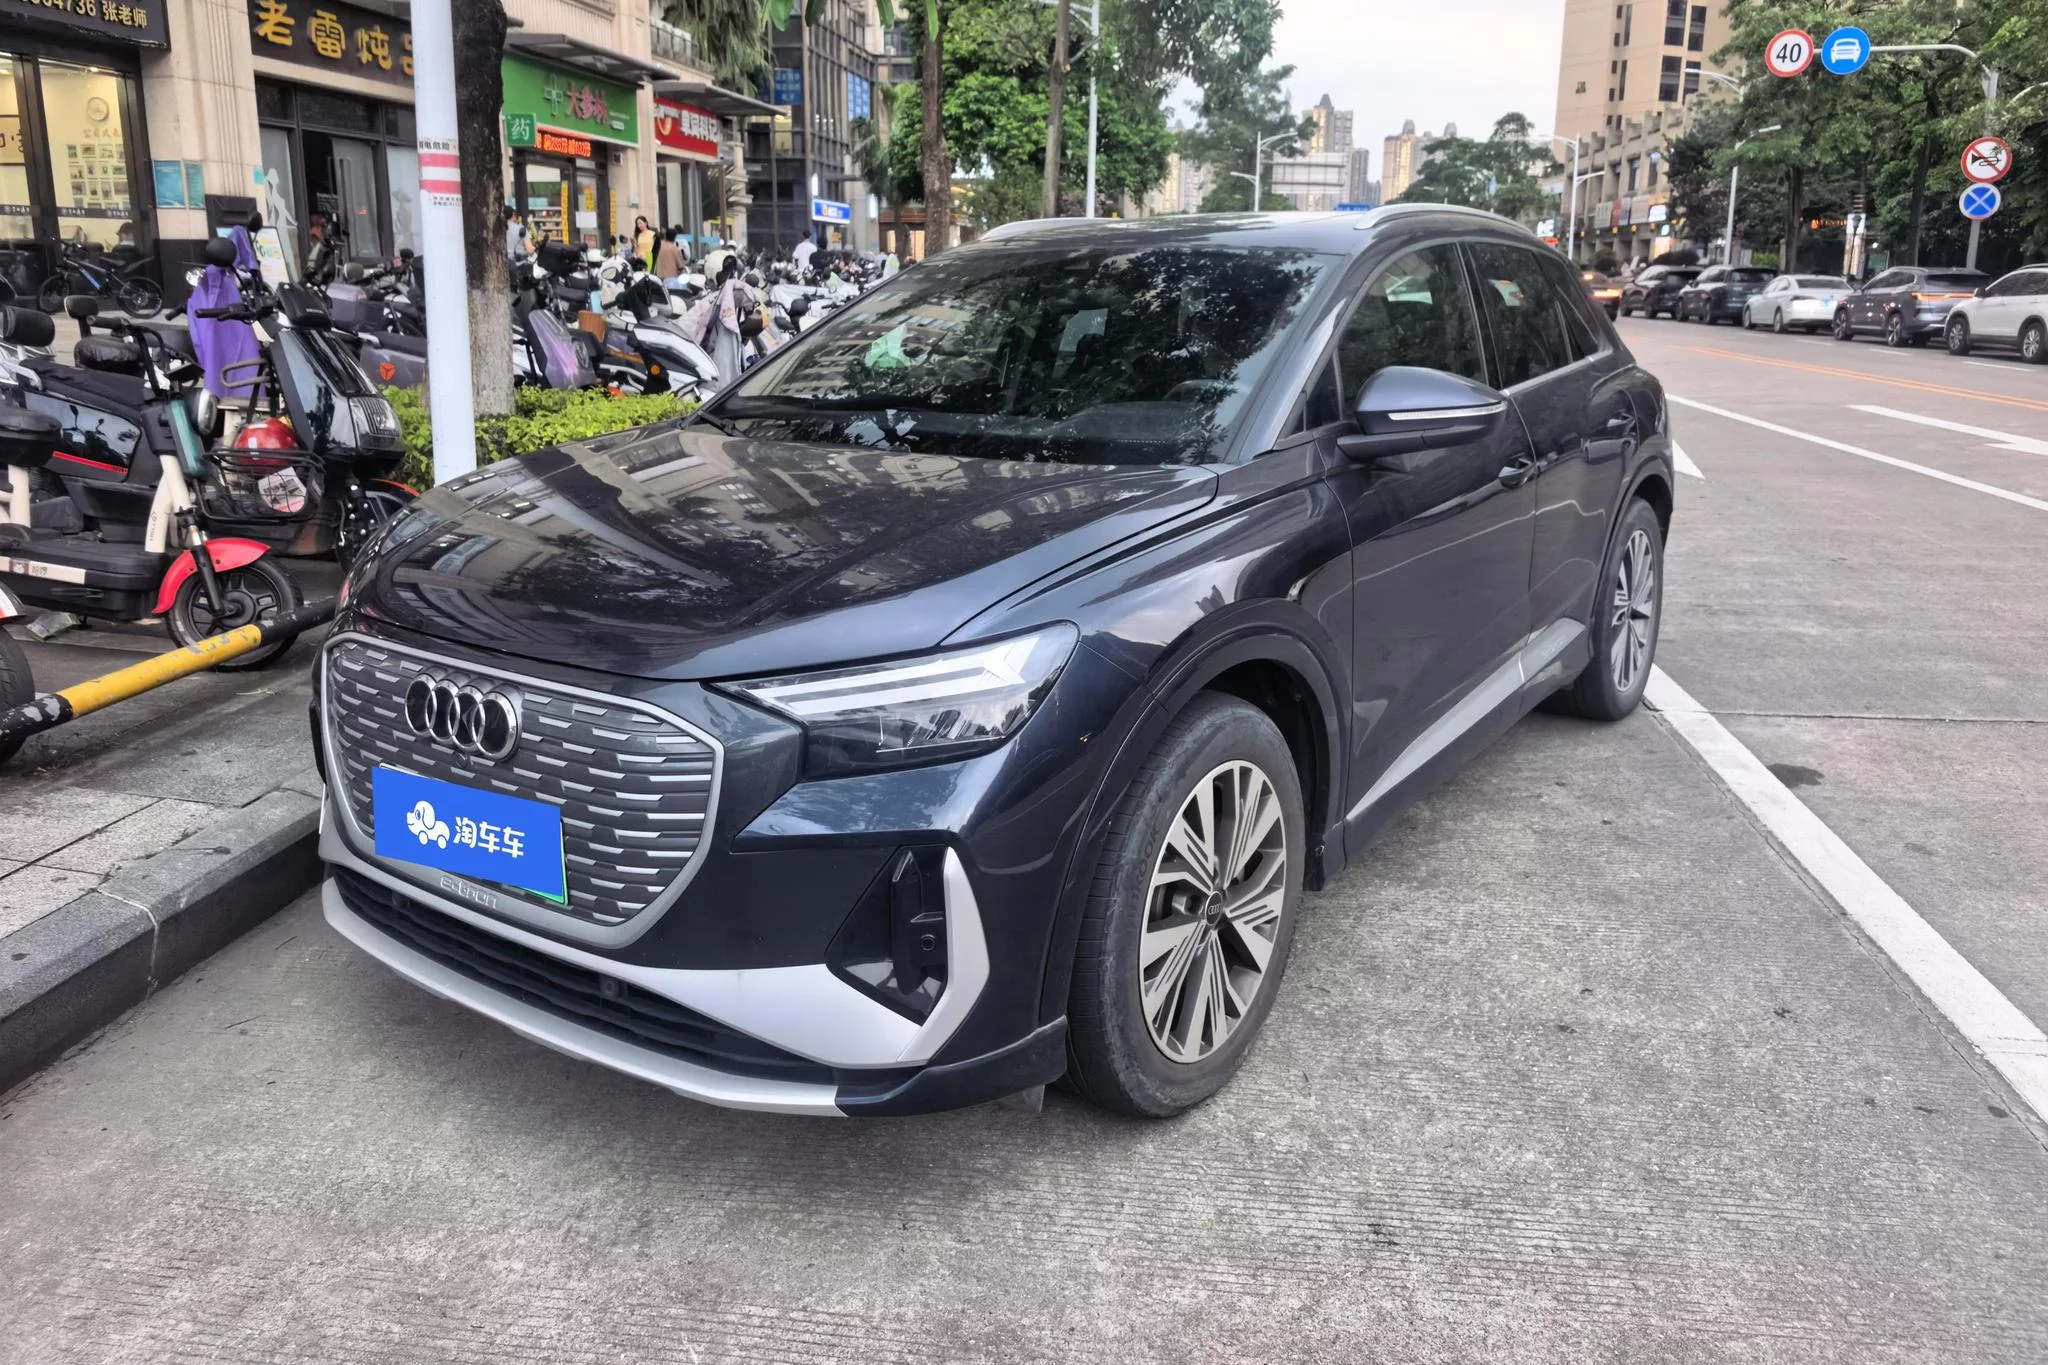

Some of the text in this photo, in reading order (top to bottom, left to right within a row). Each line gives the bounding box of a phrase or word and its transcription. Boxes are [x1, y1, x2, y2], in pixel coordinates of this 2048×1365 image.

[102, 1, 147, 29] 张老师
[1776, 42, 1802, 63] 40
[511, 117, 531, 141] 药
[440, 875, 498, 910] e-tron
